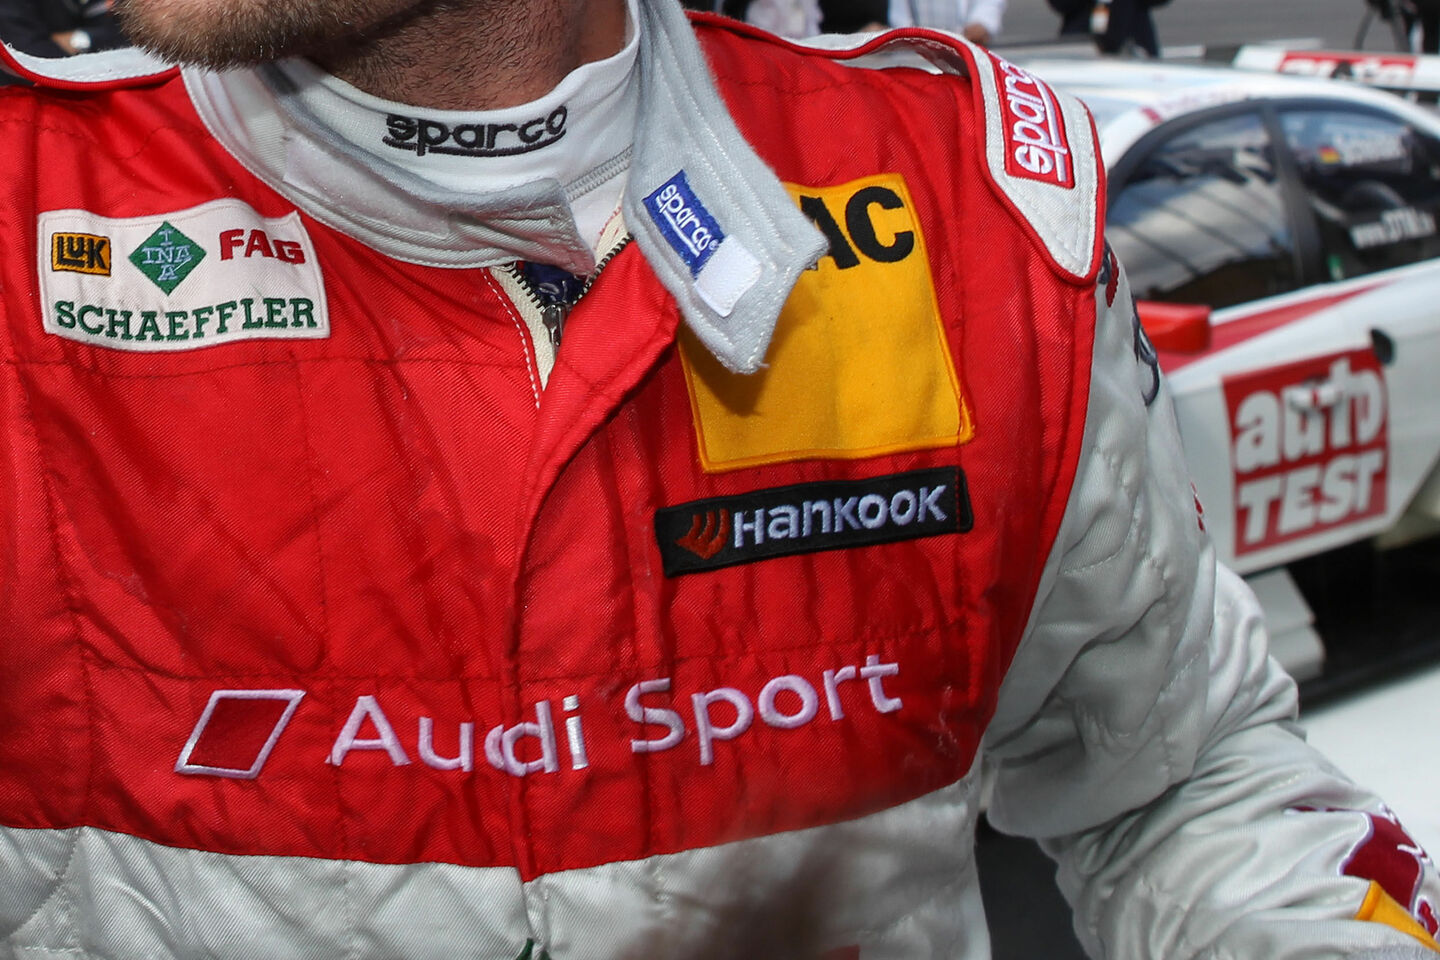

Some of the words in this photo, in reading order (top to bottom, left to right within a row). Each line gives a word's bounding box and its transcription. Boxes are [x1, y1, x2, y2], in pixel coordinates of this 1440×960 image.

[382, 105, 569, 157] sparco
[218, 228, 307, 266] FAG
[657, 183, 715, 259] sparco
[53, 296, 319, 342] SCHAEFFLER
[1235, 357, 1384, 474] auto
[1237, 448, 1385, 546] TEST
[324, 694, 591, 778] Audi
[624, 653, 904, 766] Sport
